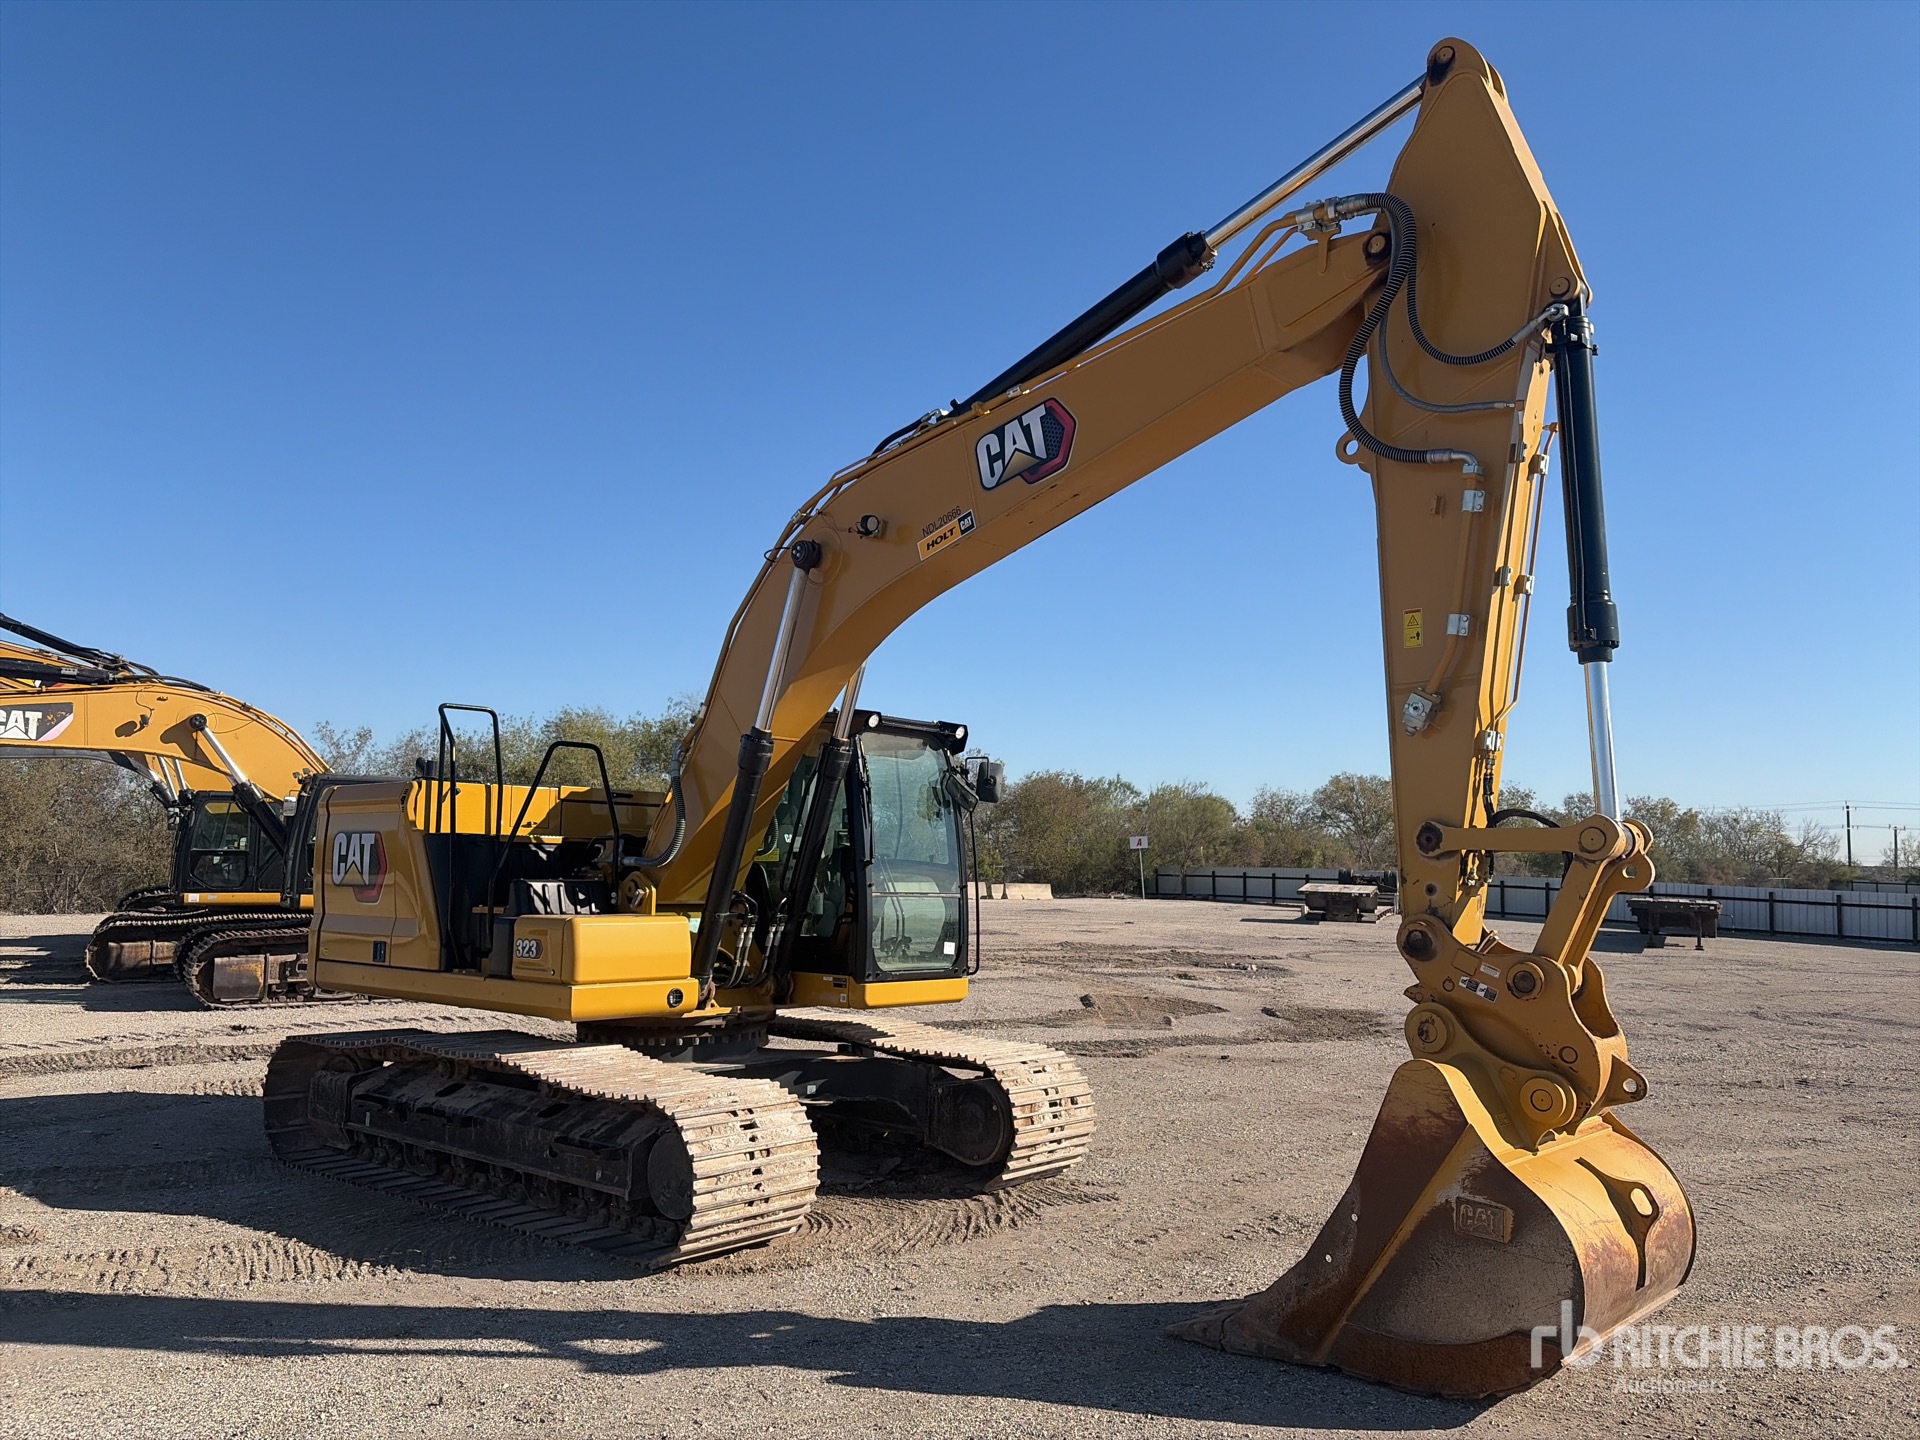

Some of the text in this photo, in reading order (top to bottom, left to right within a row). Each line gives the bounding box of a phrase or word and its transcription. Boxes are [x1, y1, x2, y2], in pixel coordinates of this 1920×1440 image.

[977, 403, 1047, 488] CAT
[960, 515, 972, 530] CAT
[926, 526, 956, 551] HOLT
[1136, 838, 1142, 847] A
[333, 832, 375, 885] CAT
[516, 939, 537, 958] 323
[1460, 1204, 1501, 1236] CAT
